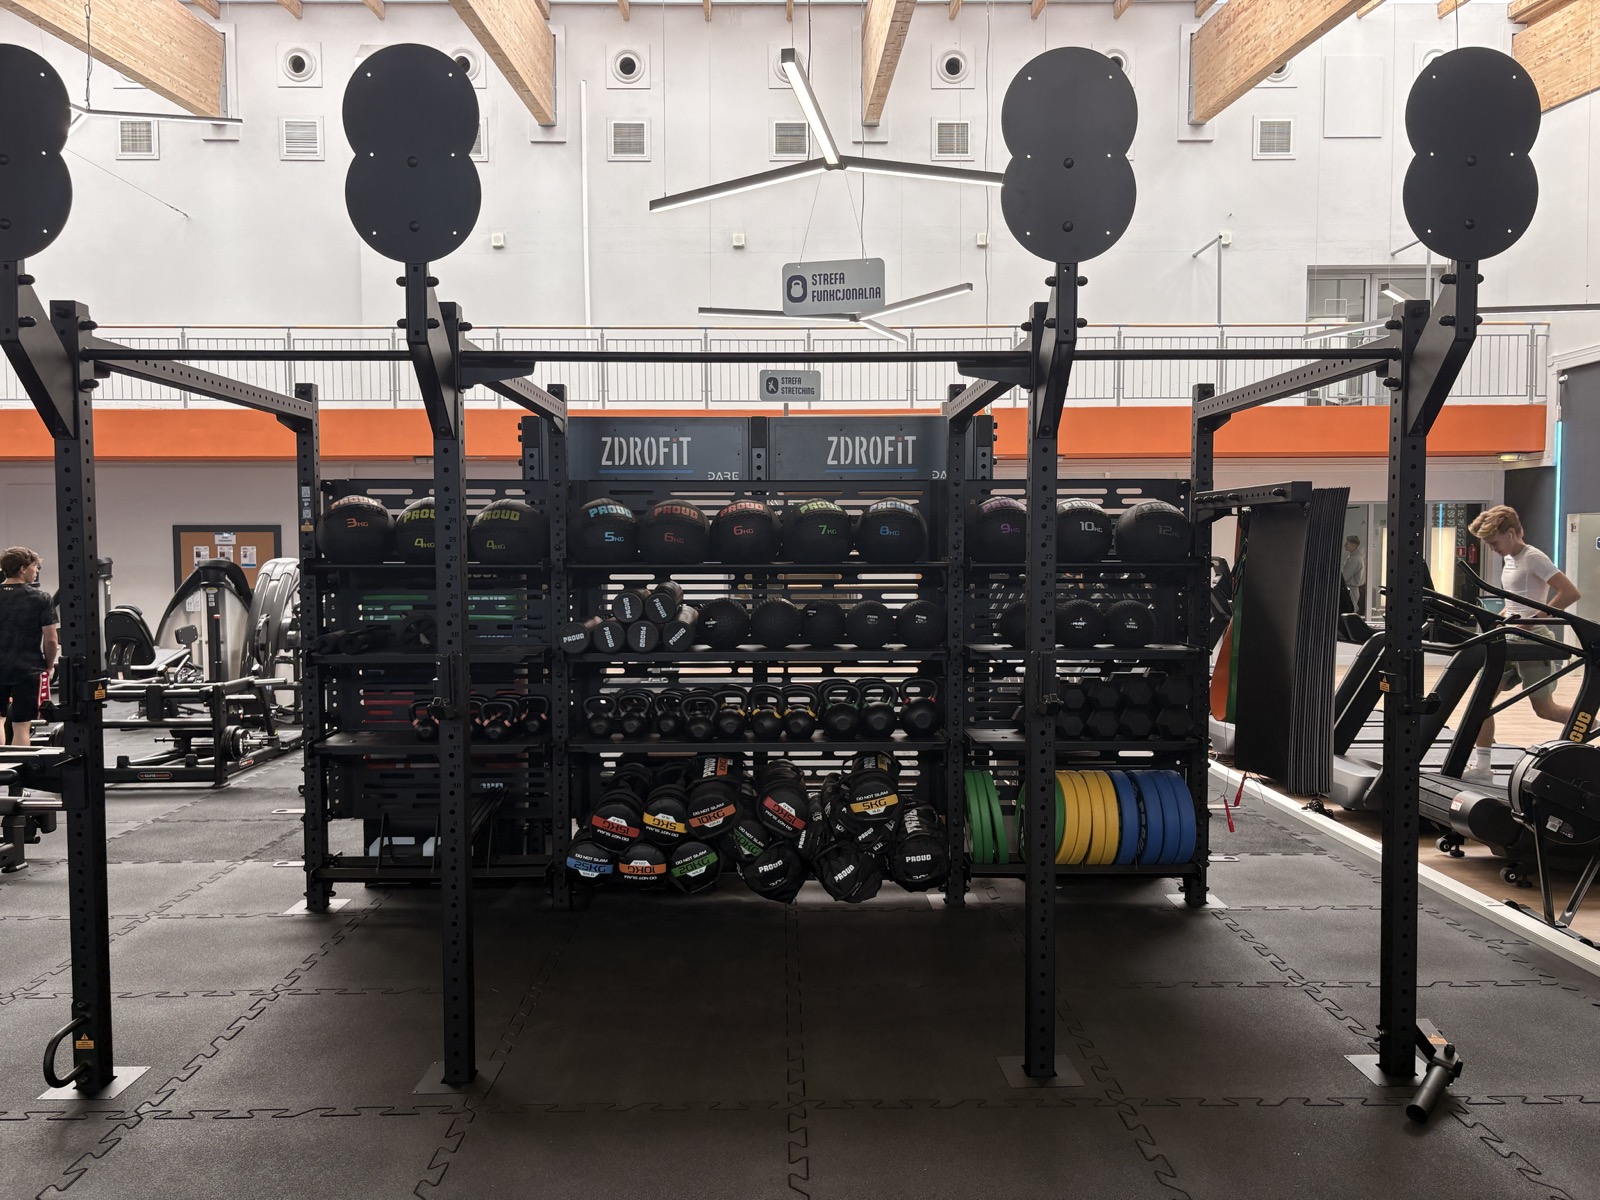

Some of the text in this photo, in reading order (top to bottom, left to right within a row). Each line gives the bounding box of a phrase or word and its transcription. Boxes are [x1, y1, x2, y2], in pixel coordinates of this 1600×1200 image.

[811, 272, 845, 286] STREFA
[811, 286, 881, 303] FUNKCJONALNA
[781, 377, 802, 385] STREFA
[781, 387, 815, 395] STRETCHING
[707, 471, 740, 481] DARE
[588, 505, 633, 518] PROUD
[654, 506, 699, 519] PROUD
[719, 502, 764, 517] PROUD
[800, 502, 843, 514] PROUD
[869, 501, 913, 512] PROUD
[403, 508, 435, 523] PROU
[477, 509, 520, 522] PROUD
[623, 597, 633, 619] PROUD
[653, 598, 667, 618] PROUD
[563, 632, 585, 643] PROUD
[603, 626, 615, 648] PROUD
[668, 627, 686, 645] PROUD
[1569, 711, 1592, 743] OUD
[862, 799, 887, 810] 5KG
[698, 810, 725, 825] 10KG
[773, 804, 796, 824] 15KG
[602, 821, 629, 835] 15KG
[653, 818, 677, 830] 5KG
[857, 827, 874, 841] PROUD
[678, 857, 710, 874] 20KG
[905, 854, 932, 863] PROUD
[574, 860, 606, 873] 25KG
[628, 866, 655, 874] 10KG
[758, 859, 783, 874] PROUD
[834, 865, 855, 883] PROUD
